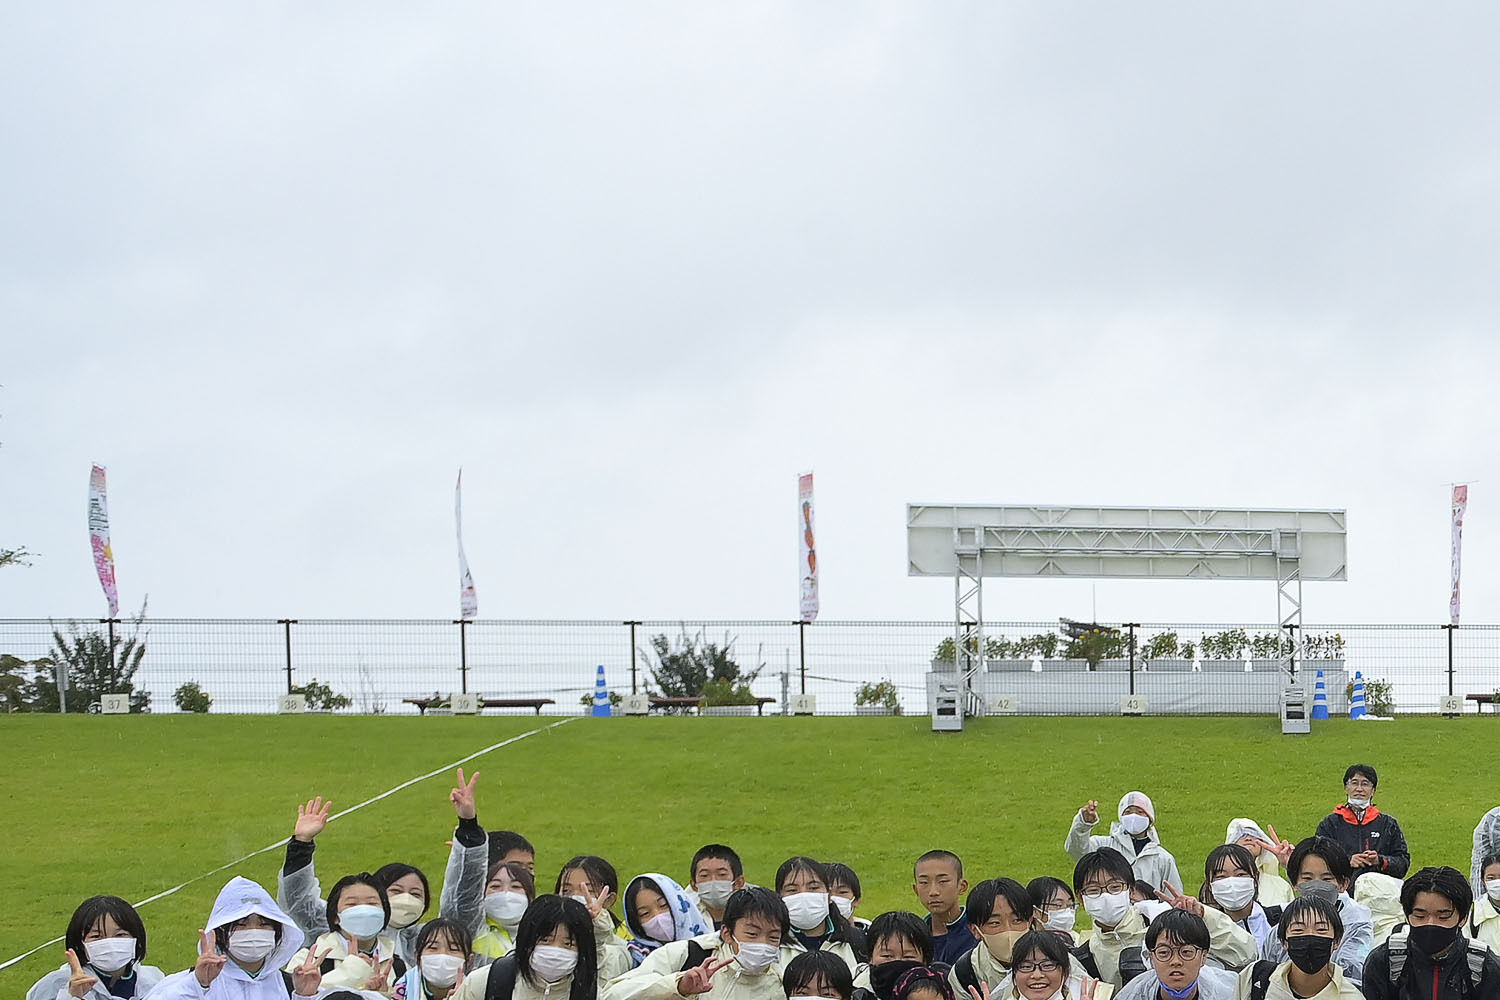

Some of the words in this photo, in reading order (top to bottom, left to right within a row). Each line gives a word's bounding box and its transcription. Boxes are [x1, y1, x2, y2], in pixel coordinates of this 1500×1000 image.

[109, 700, 120, 710] 37
[285, 700, 296, 710] 38
[797, 699, 808, 710] 41
[997, 699, 1009, 710] 42
[1127, 699, 1139, 710] 43
[1445, 699, 1457, 710] 45
